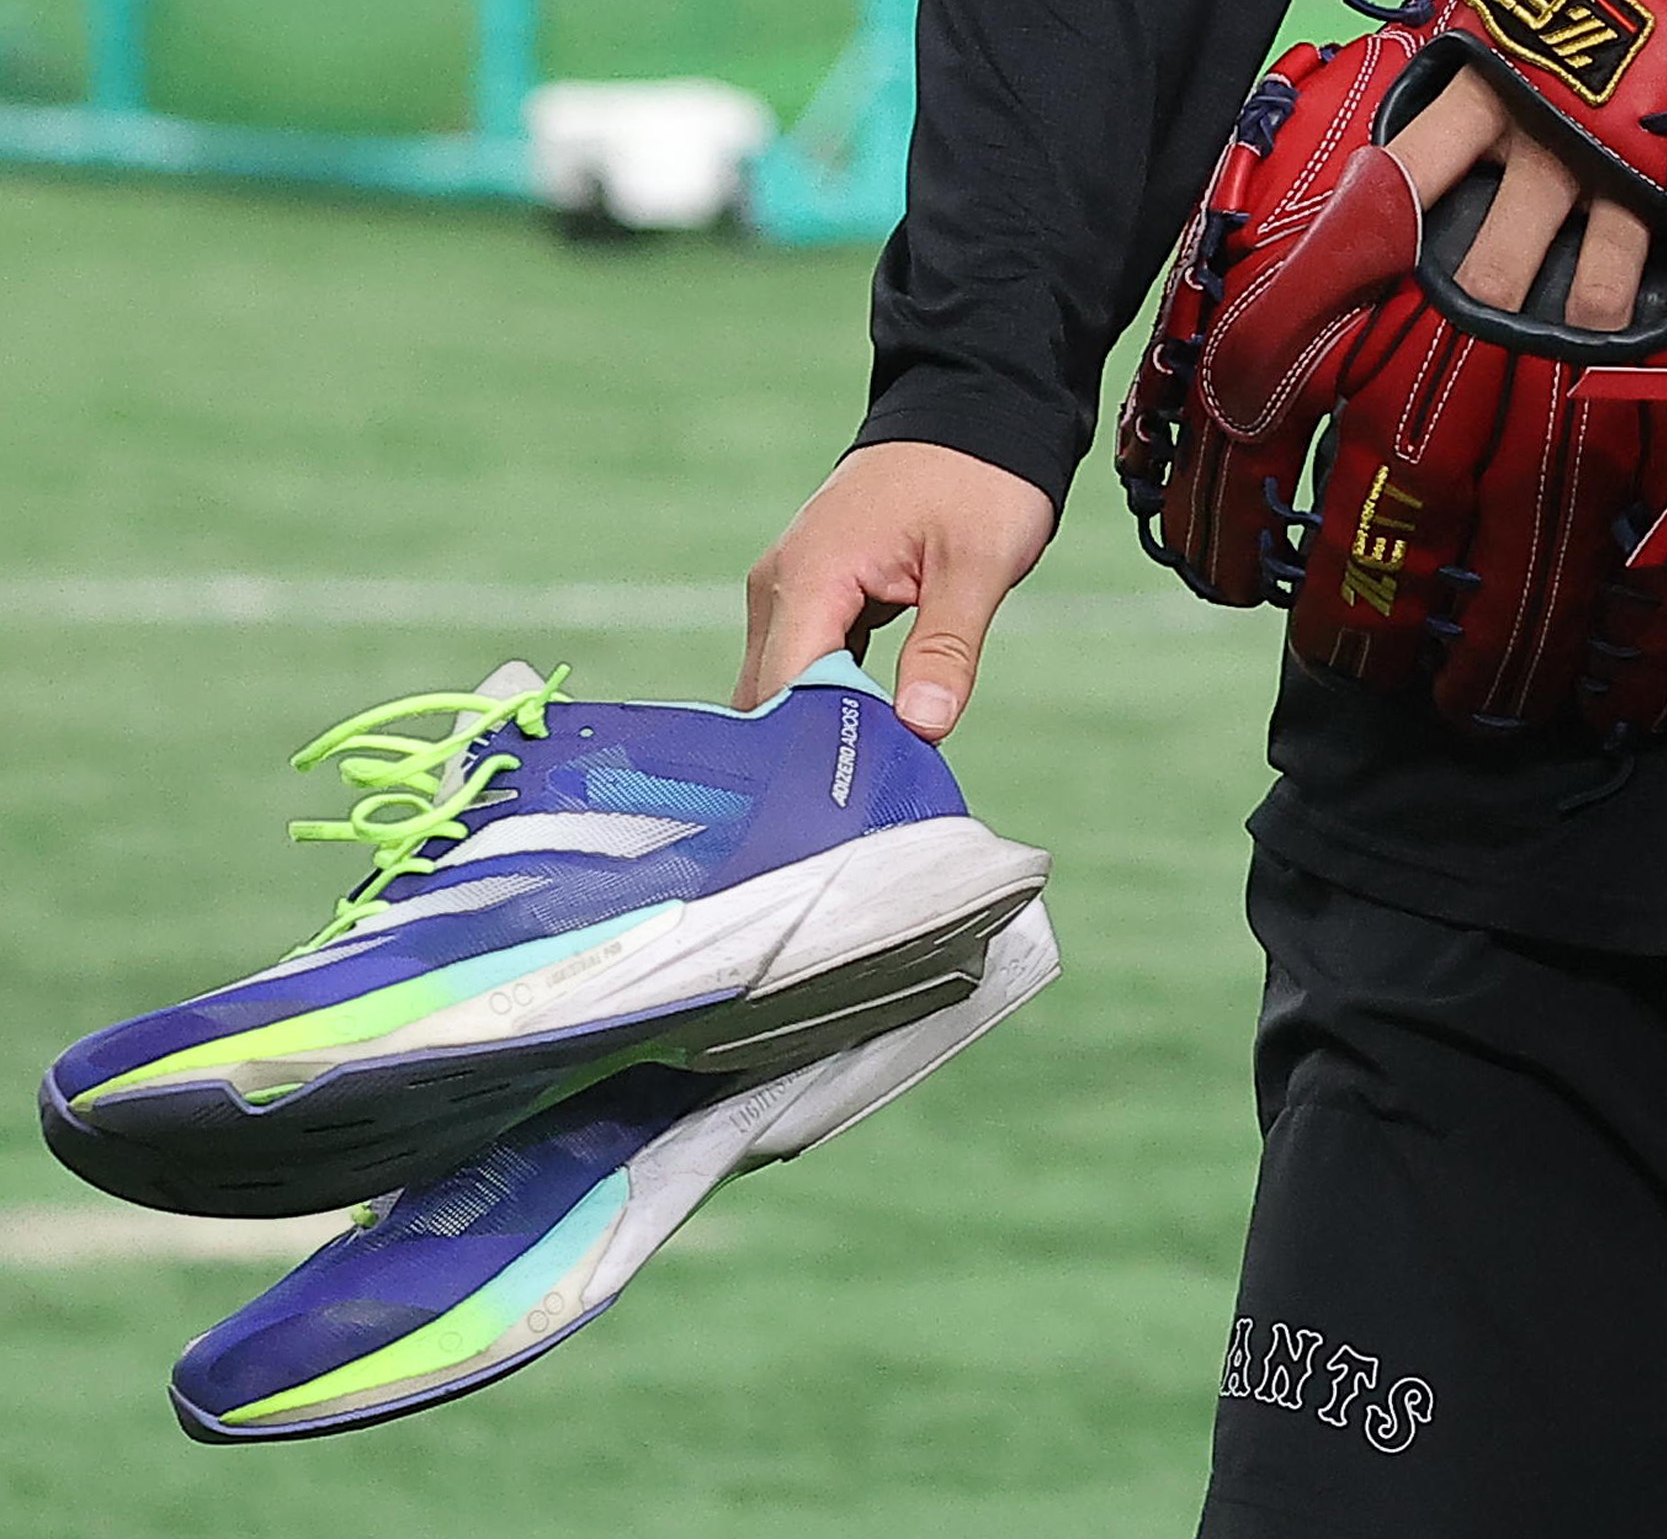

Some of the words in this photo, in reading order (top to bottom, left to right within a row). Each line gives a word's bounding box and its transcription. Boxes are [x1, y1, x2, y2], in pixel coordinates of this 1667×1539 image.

[1340, 464, 1424, 618] ZETT
[840, 706, 860, 749] ADIOS
[830, 744, 857, 809] ADIZERO
